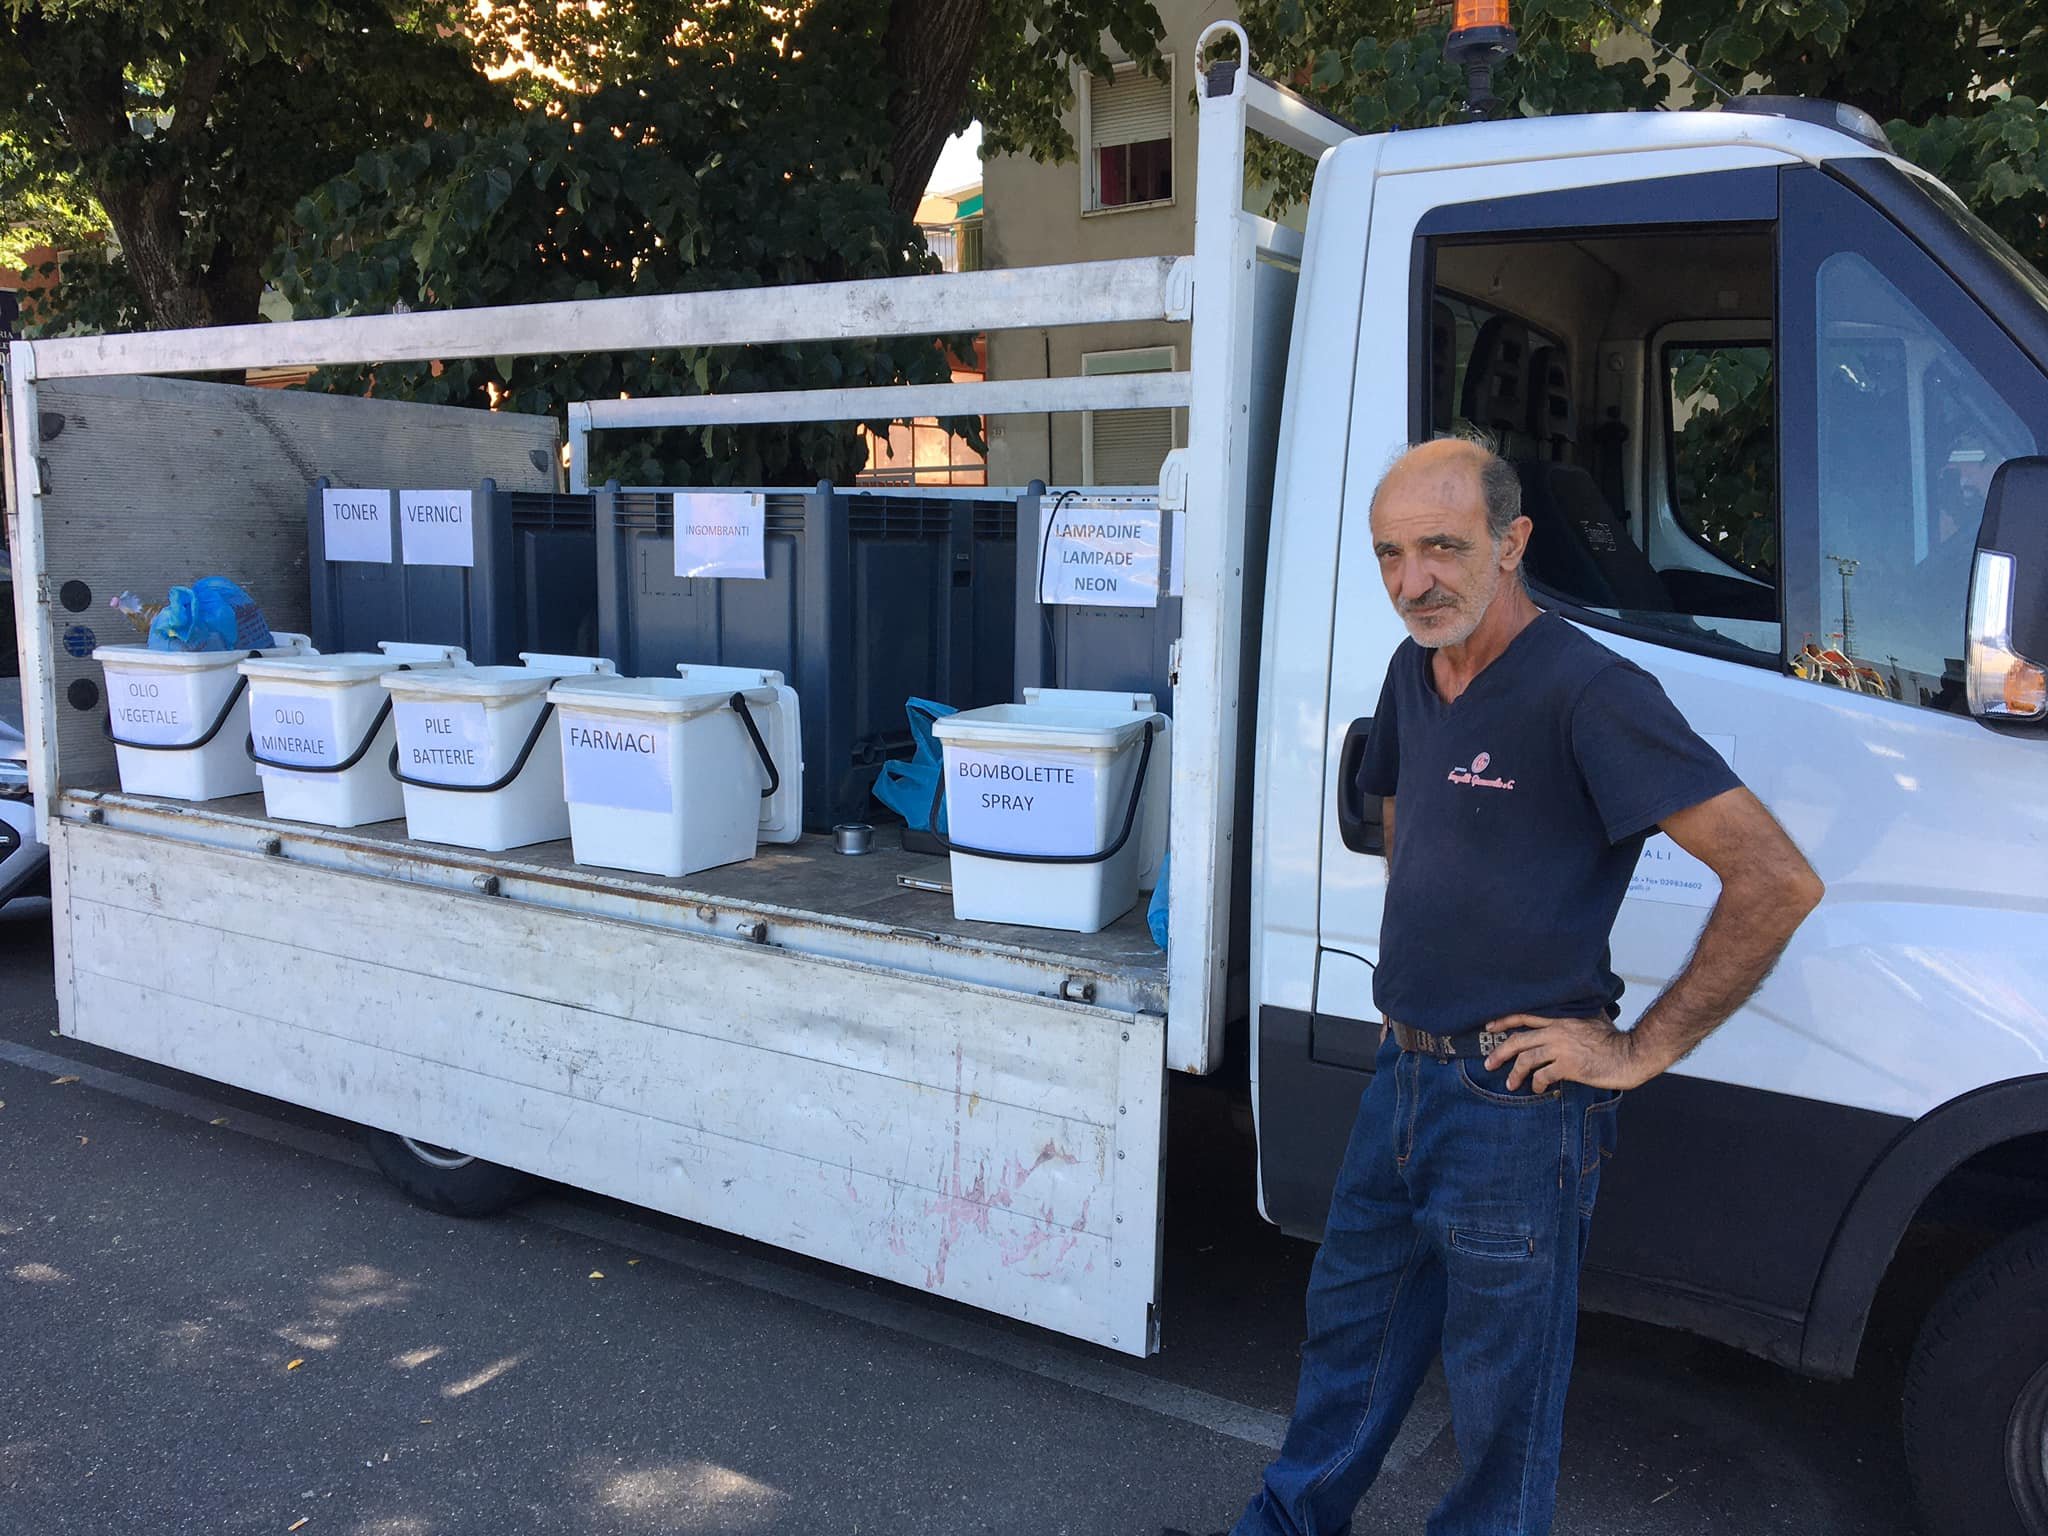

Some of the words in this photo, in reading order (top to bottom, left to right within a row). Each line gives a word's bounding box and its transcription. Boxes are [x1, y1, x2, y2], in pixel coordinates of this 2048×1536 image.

[332, 503, 379, 521] TONER
[407, 504, 463, 524] VERNICI
[685, 524, 750, 537] INGOMBRANTI
[1055, 523, 1142, 539] LAMPADINE
[1062, 550, 1133, 566] LAMPADE
[1074, 576, 1118, 592] NEON
[128, 683, 159, 699] OLIO
[118, 707, 179, 725] VEGETALE
[274, 708, 305, 726] OLIO
[424, 718, 453, 735] PILE
[260, 735, 325, 756] MINERALE
[570, 727, 656, 755] FARMACI
[412, 748, 476, 766] BATTERIE
[958, 762, 1075, 785] BOMBOLETTE
[981, 793, 1034, 812] SPRAY
